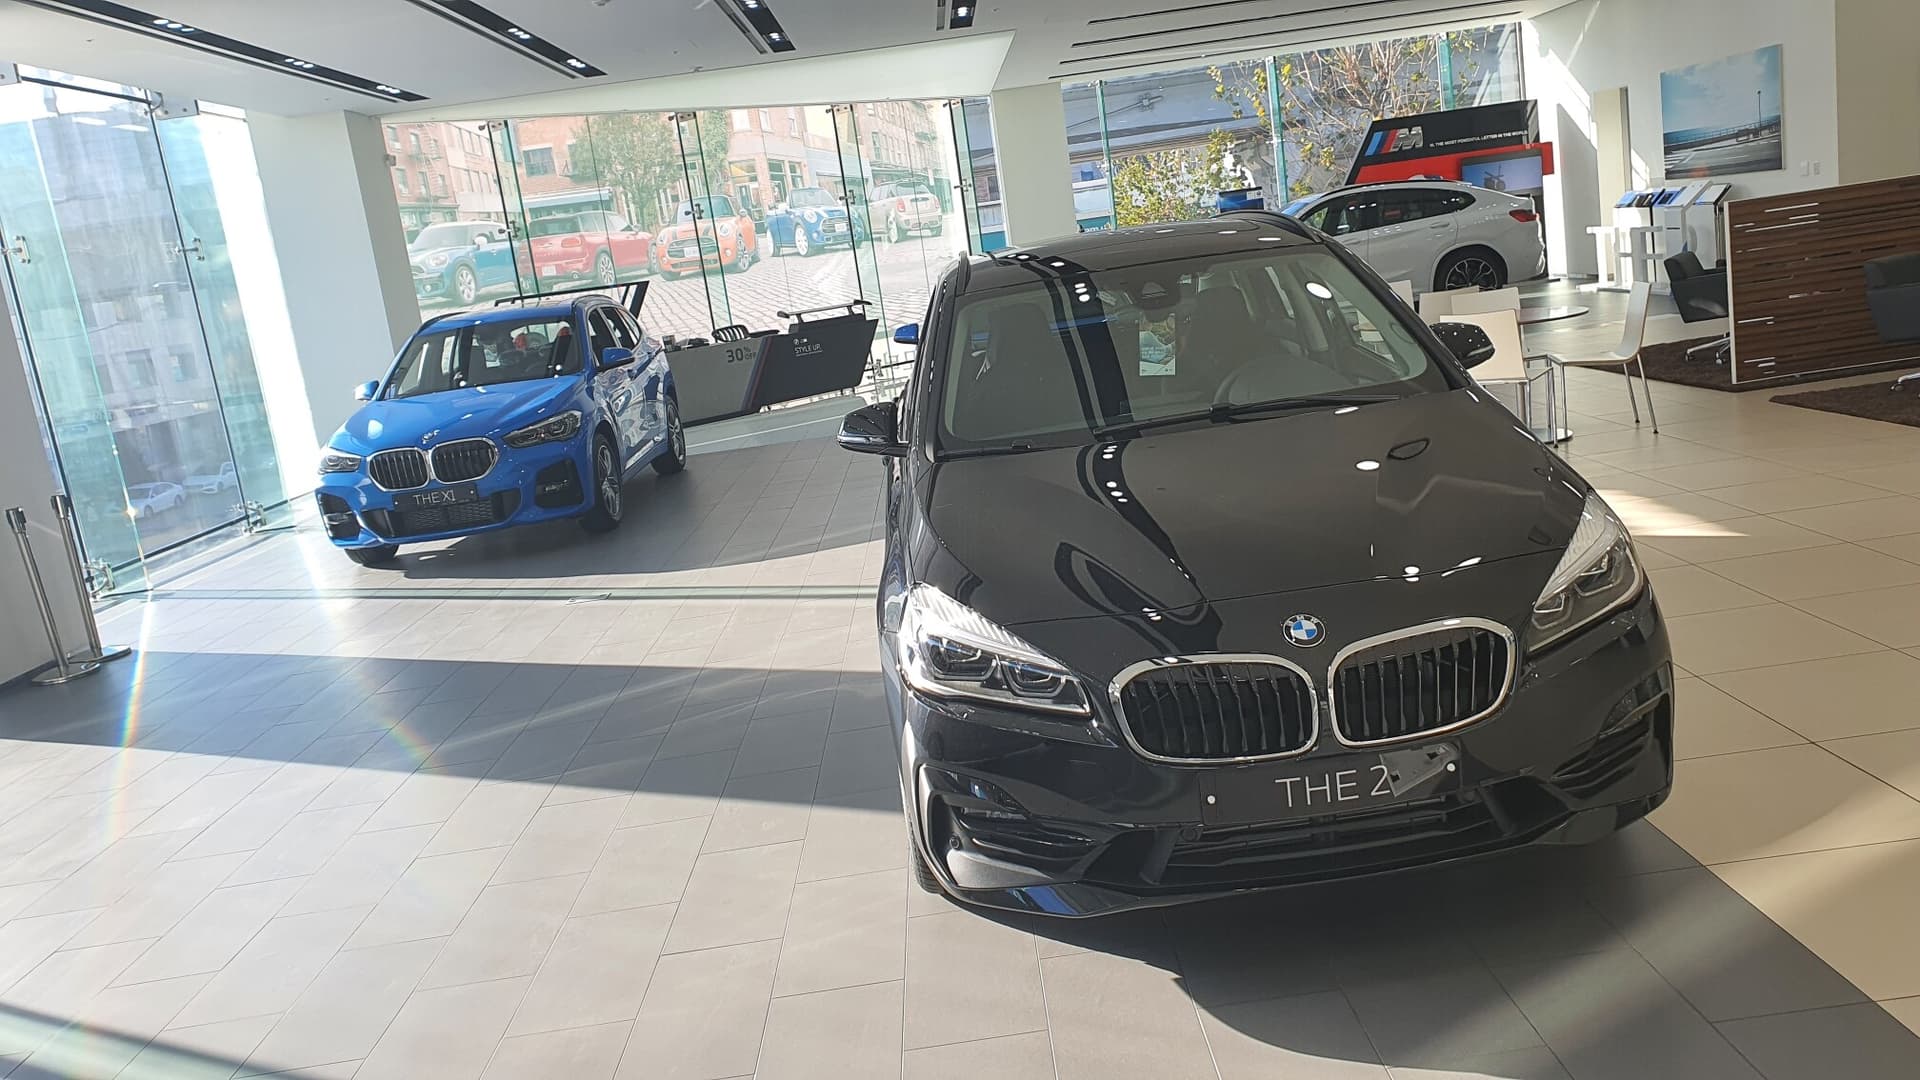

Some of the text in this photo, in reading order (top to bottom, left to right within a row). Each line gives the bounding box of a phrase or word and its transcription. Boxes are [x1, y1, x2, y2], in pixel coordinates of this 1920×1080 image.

[1391, 126, 1424, 152] M
[795, 345, 812, 354] STYLE
[412, 489, 456, 505] THE X1
[1275, 764, 1392, 807] THE 2
